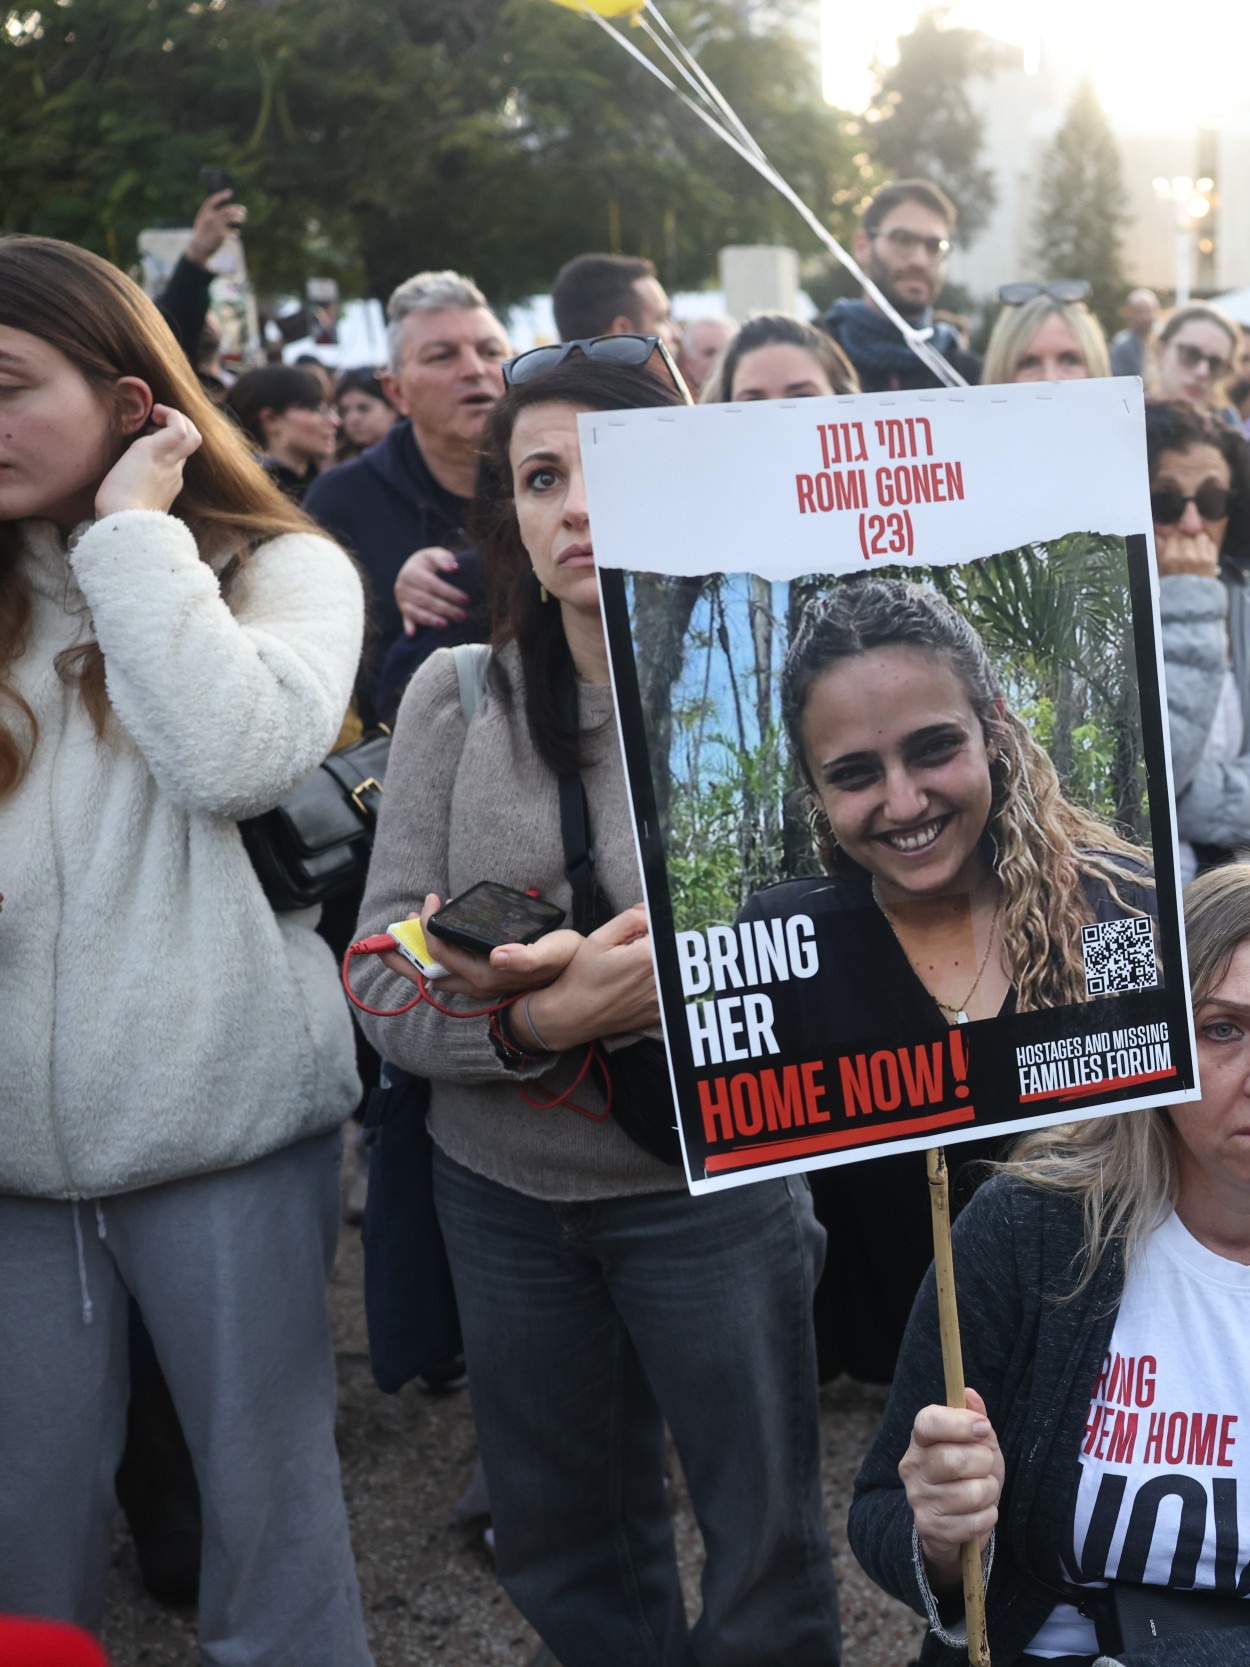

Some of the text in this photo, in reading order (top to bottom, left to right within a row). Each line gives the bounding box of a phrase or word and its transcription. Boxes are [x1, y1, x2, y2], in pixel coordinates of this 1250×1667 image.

[817, 417, 933, 469] רומי גונן
[795, 461, 965, 514] ROMI GONEN
[859, 509, 914, 560] (23)
[675, 914, 820, 997] BRING
[685, 993, 781, 1067] HER
[1016, 1021, 1169, 1067] HOSTAGES AND MISSING
[697, 1029, 970, 1144] HOME NOW!
[1018, 1042, 1172, 1096] FAMILIES FORUM
[1091, 1351, 1157, 1408] RING
[1083, 1403, 1238, 1467] HEM HOME
